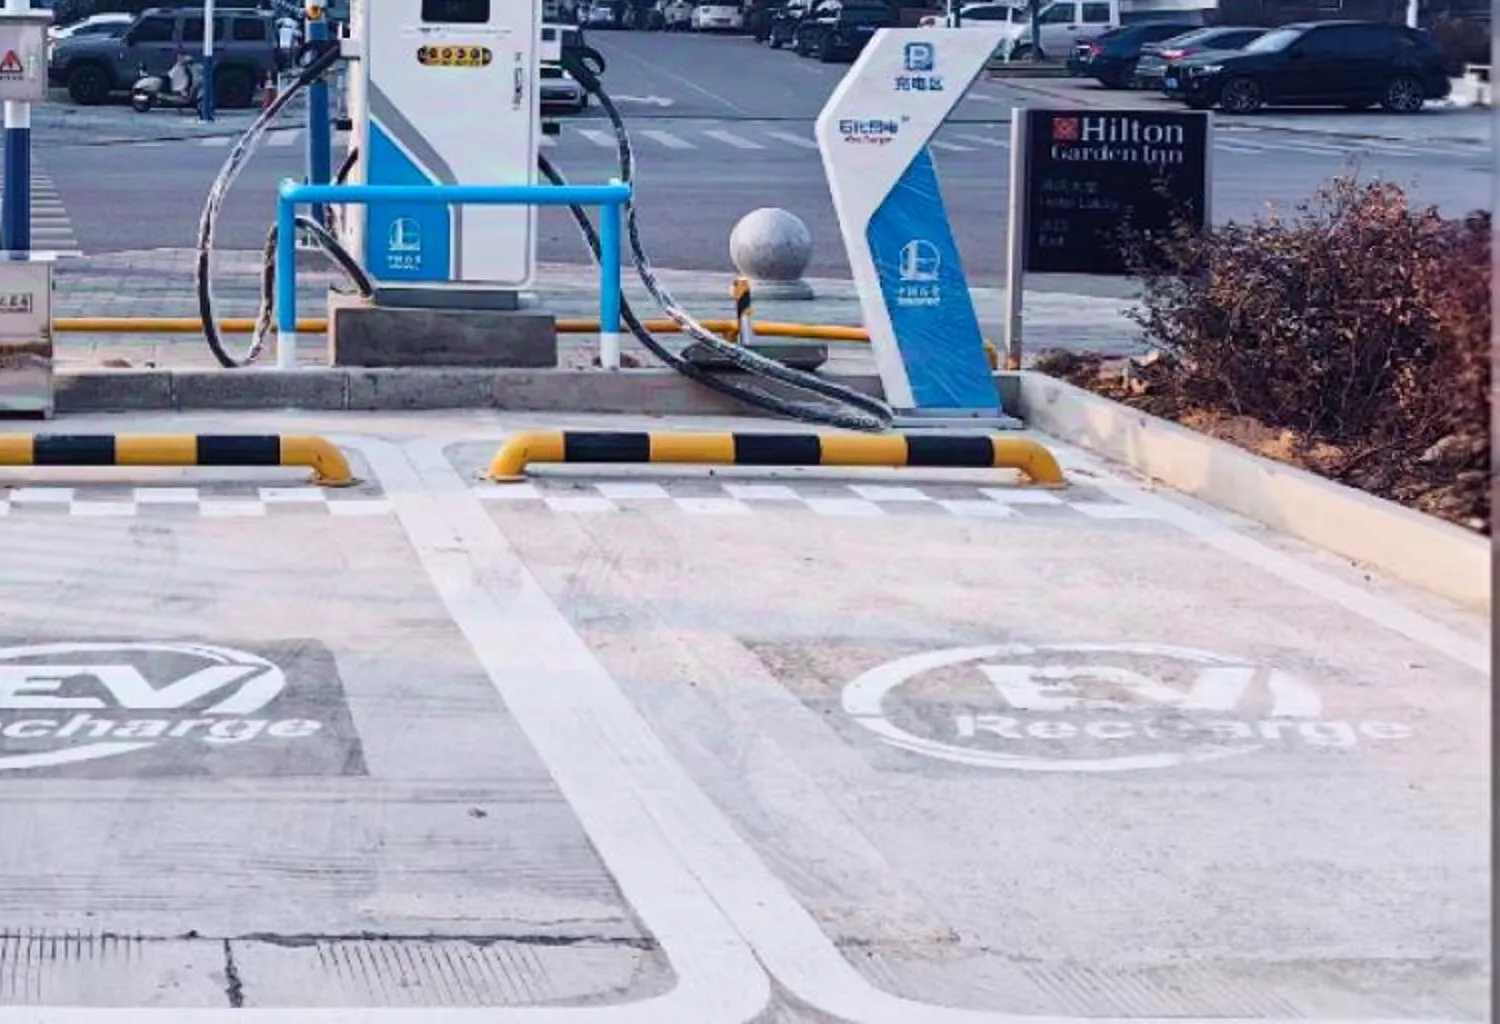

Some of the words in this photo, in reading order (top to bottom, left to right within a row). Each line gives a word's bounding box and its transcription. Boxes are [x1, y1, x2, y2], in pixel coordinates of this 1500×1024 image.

[1081, 116, 1184, 144] Hilton
[1051, 144, 1138, 161] Garden
[1143, 145, 1184, 164] Inn
[980, 664, 1255, 710] EV
